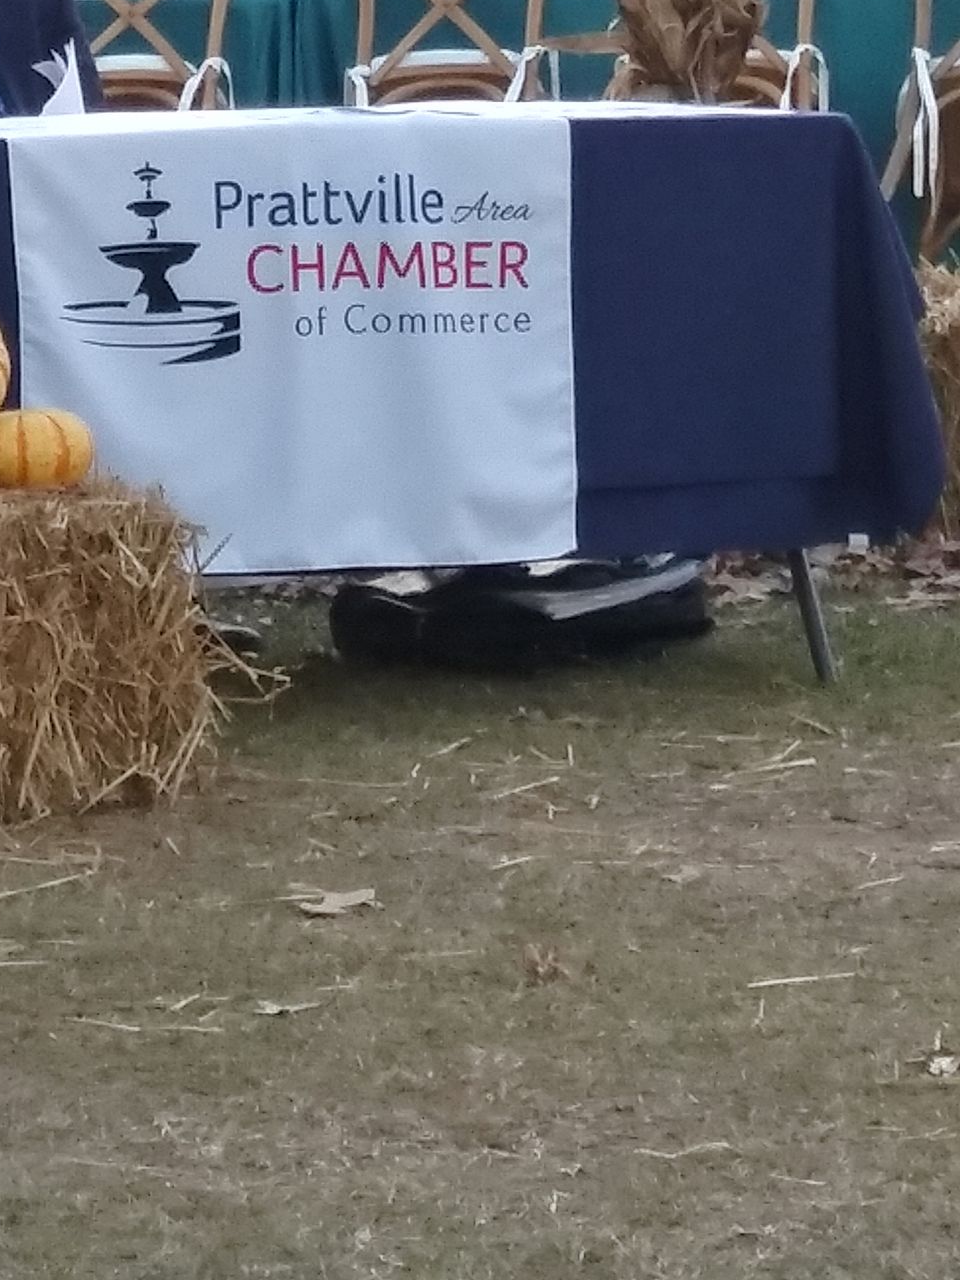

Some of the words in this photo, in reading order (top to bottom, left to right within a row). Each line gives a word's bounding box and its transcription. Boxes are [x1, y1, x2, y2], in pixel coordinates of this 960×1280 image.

[213, 173, 444, 229] Prattville
[450, 190, 534, 225] Area
[246, 240, 530, 294] CHAMBER
[294, 305, 328, 337] of
[343, 304, 532, 335] Commerce
